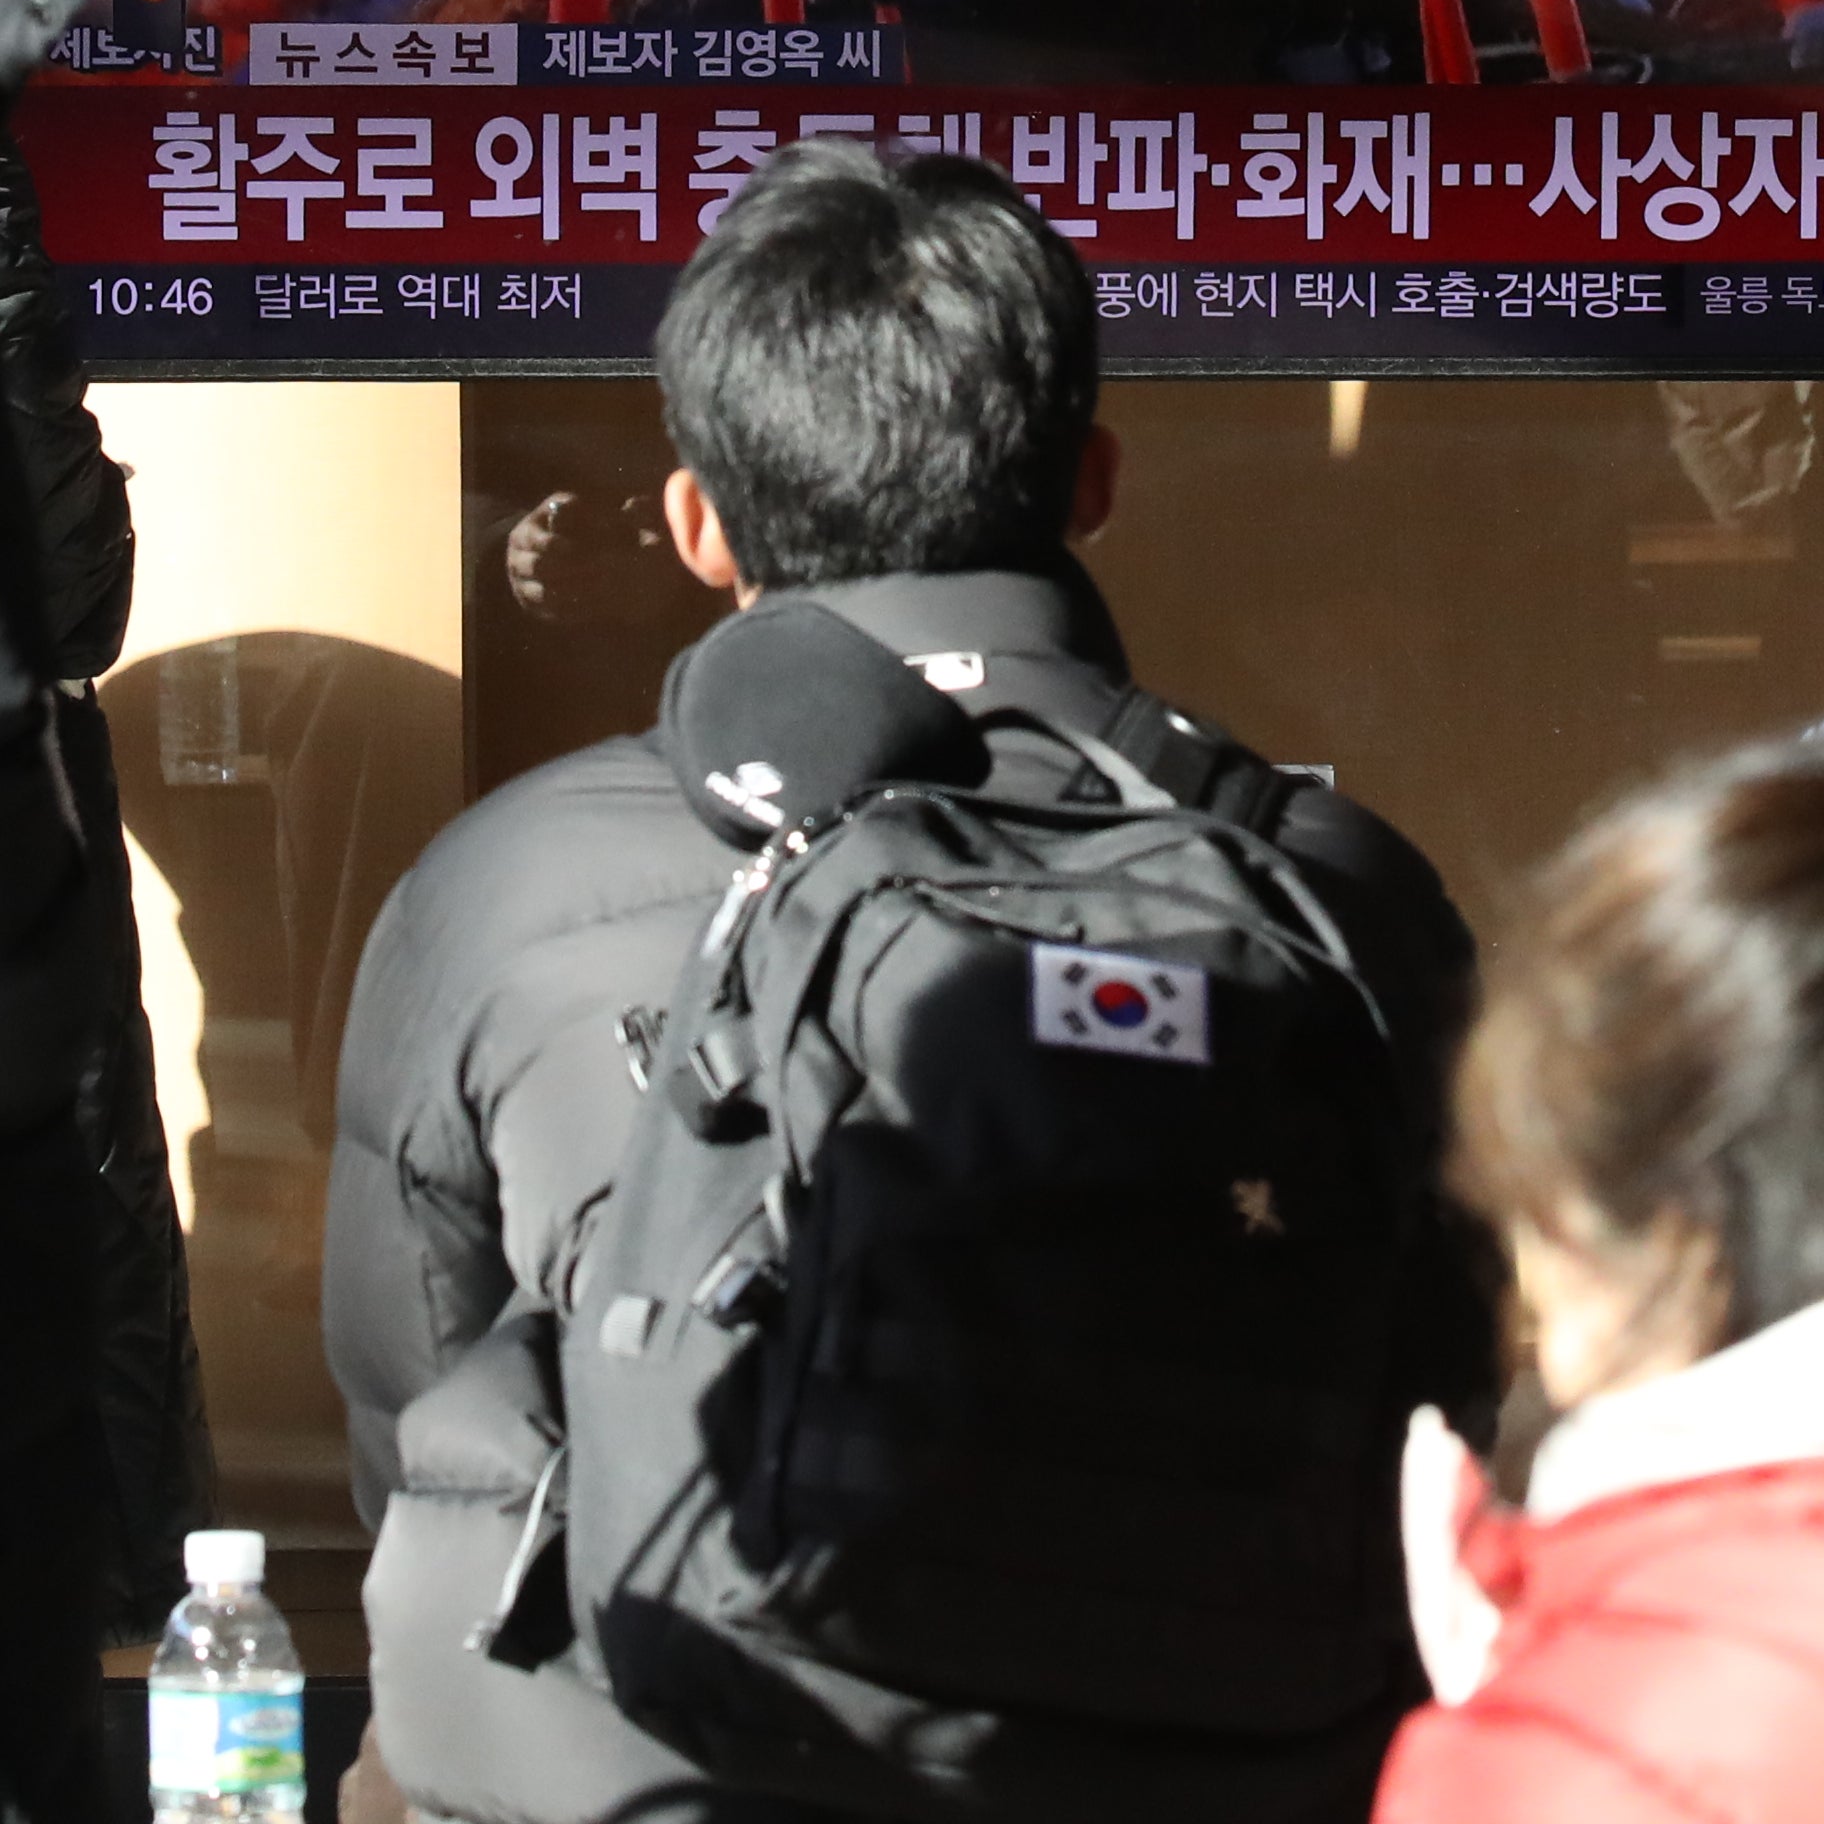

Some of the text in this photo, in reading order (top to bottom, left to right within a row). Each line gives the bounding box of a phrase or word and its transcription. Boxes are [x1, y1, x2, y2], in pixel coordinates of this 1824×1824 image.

[49, 26, 216, 72] 제보진
[275, 30, 495, 79] 뉴스속보
[543, 30, 880, 79] 제보자 김영옥 씨
[148, 112, 444, 242] 활주로
[470, 113, 657, 242] 외벽
[89, 277, 213, 316] 10:46
[255, 273, 581, 320] 달러로 역대 최저
[1193, 272, 1277, 319] 현지
[1295, 272, 1376, 319] 택시
[1700, 276, 1773, 314] 울릉
